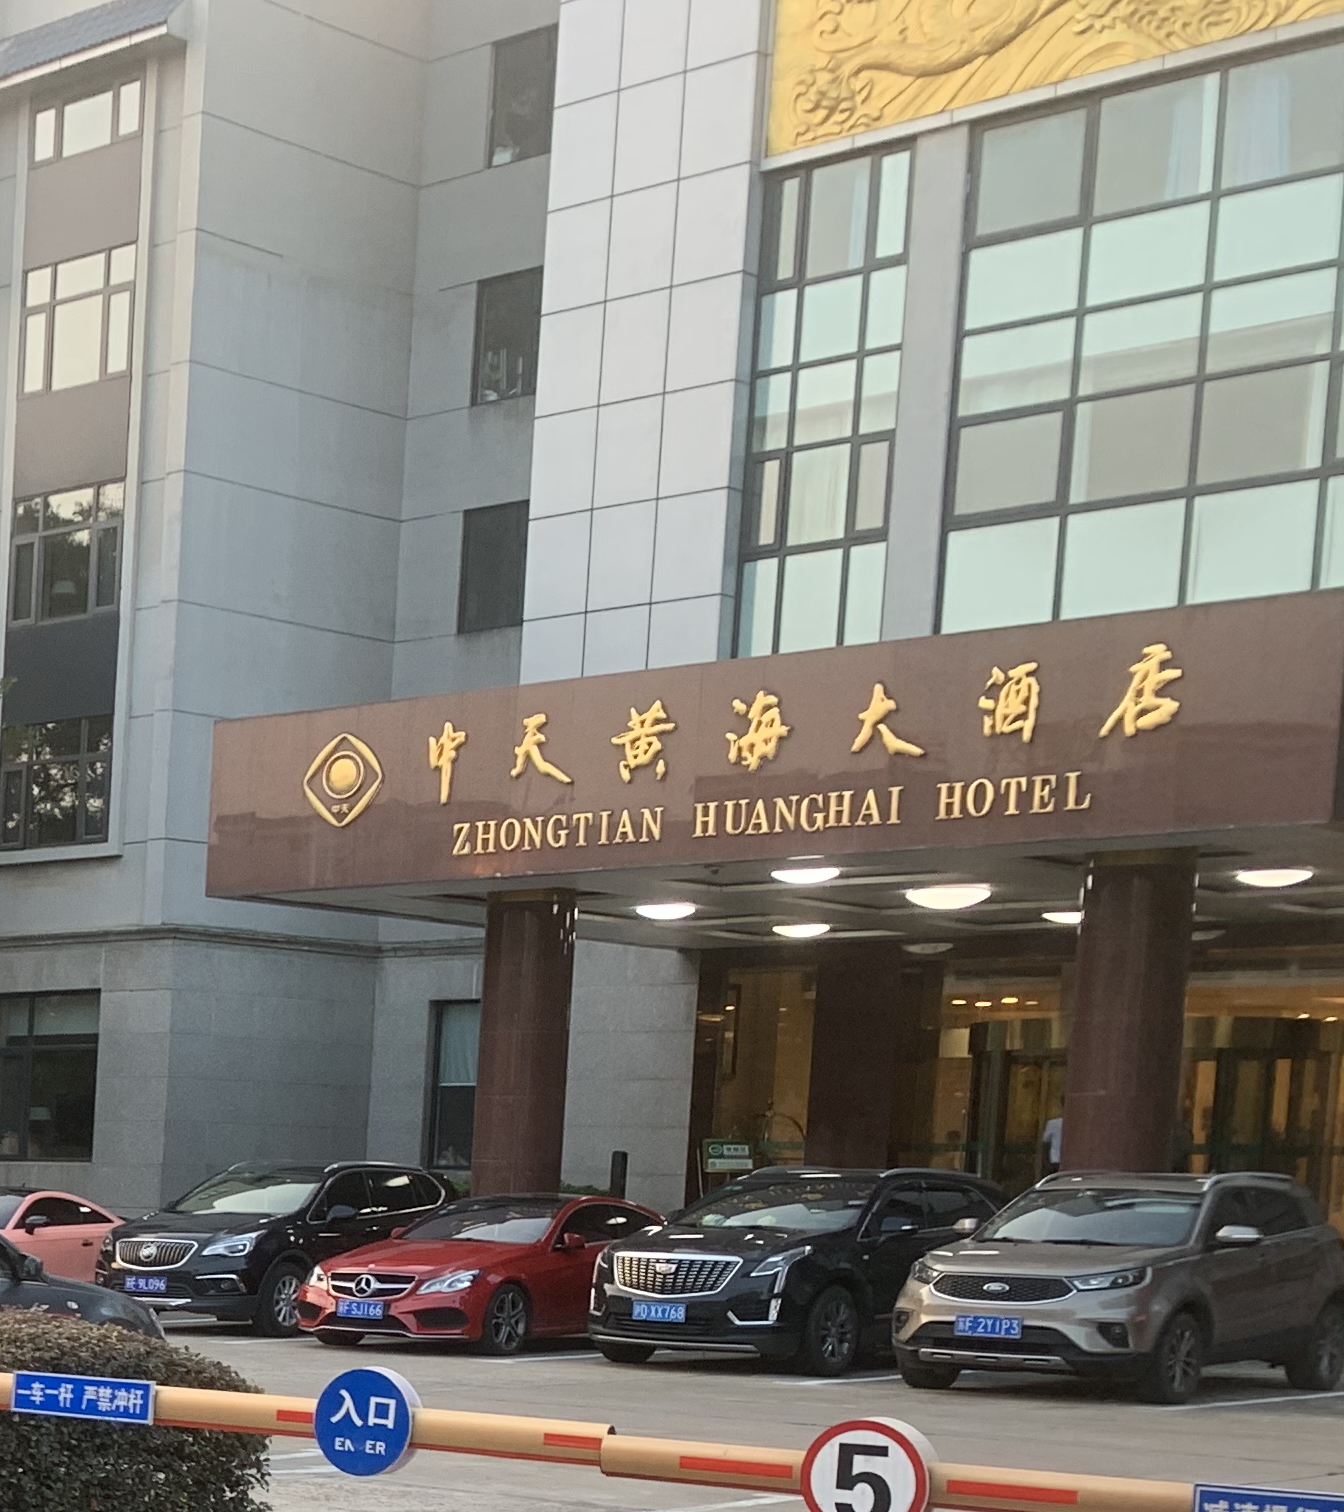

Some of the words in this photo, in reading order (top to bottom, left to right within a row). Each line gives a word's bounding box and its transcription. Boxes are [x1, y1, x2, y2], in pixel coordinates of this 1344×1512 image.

[427, 642, 1184, 806] 中天黄海大酒店
[452, 806, 664, 857] ZHONGTIAN
[691, 785, 905, 839] HUANGHAI
[934, 770, 1093, 822] HOTEL
[17, 1381, 74, 1408] 一车一杆
[81, 1384, 145, 1415] 严禁冲杆
[329, 1388, 397, 1430] 入口
[334, 1436, 387, 1457] ENER
